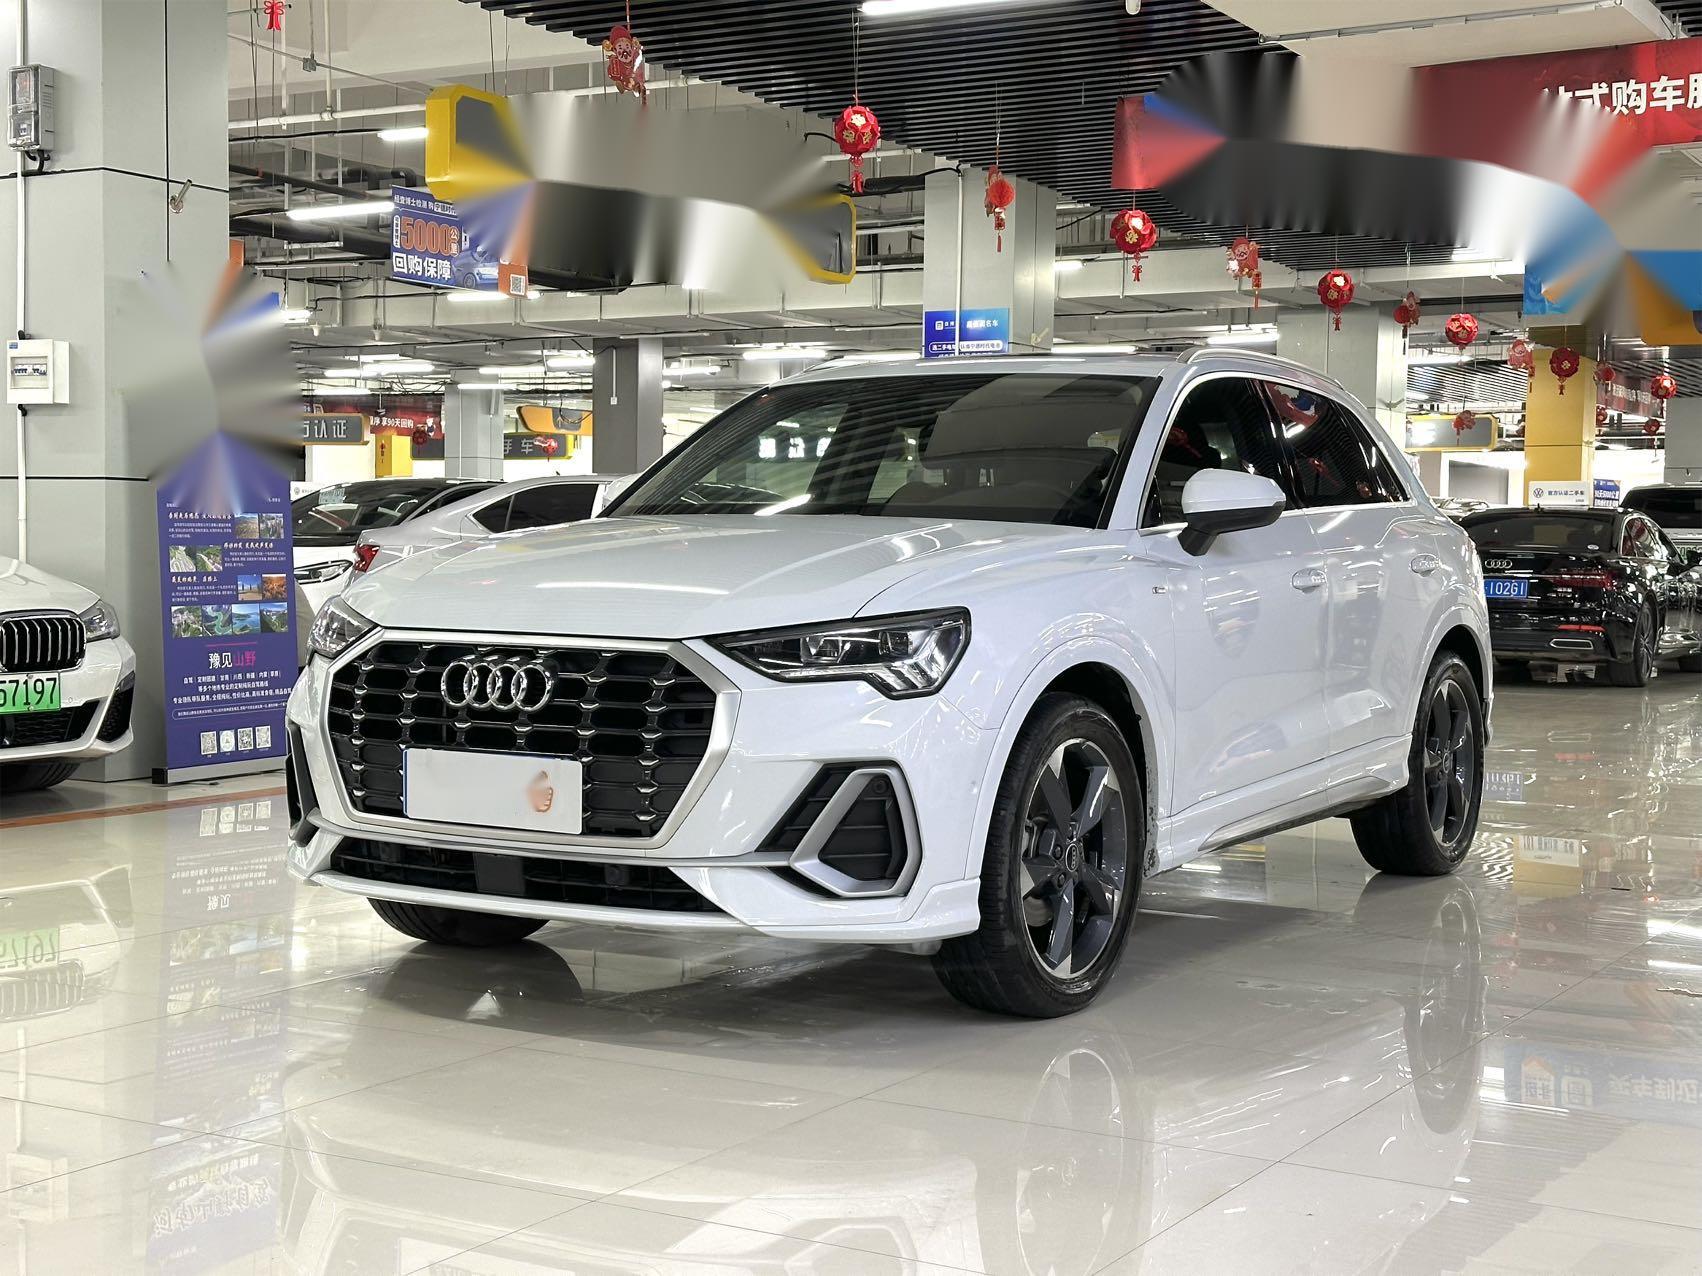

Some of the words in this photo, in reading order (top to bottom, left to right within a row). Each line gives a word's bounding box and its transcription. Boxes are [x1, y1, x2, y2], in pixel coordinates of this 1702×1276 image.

[392, 252, 452, 280] 回购保障
[208, 650, 257, 670] 豫见山野
[0, 678, 57, 707] 57197
